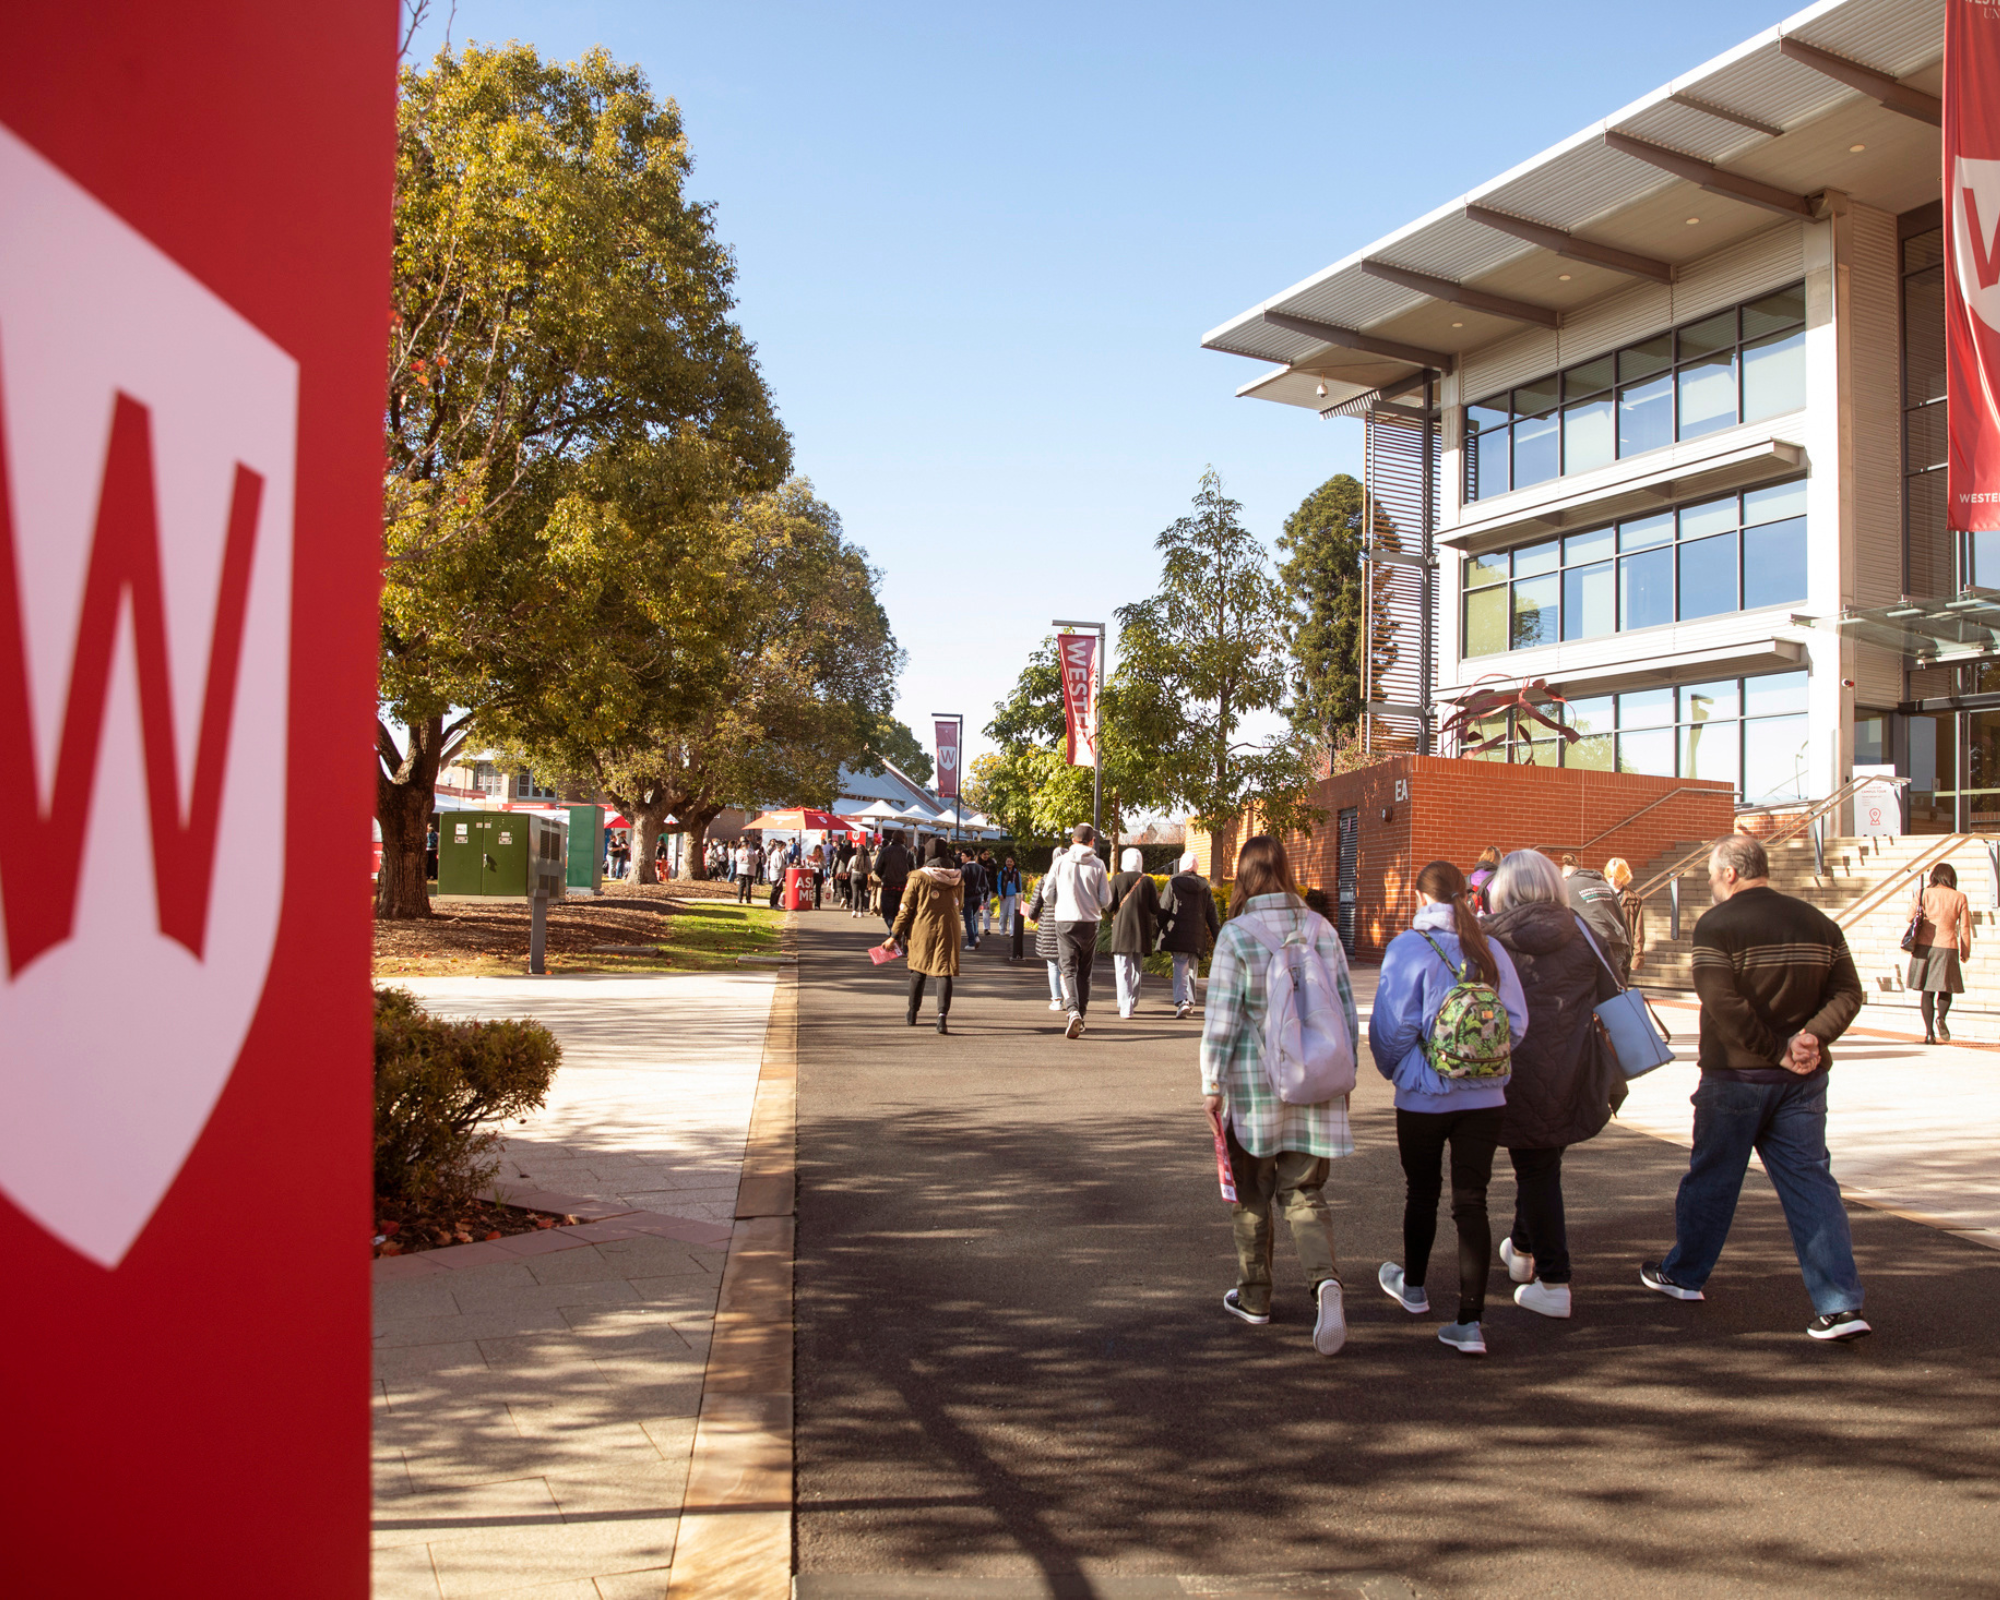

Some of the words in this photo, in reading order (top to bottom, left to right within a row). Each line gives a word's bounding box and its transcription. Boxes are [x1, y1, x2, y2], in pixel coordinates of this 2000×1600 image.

[1959, 493, 2000, 503] WESTE
[941, 749, 955, 764] W
[1395, 779, 1408, 801] EA
